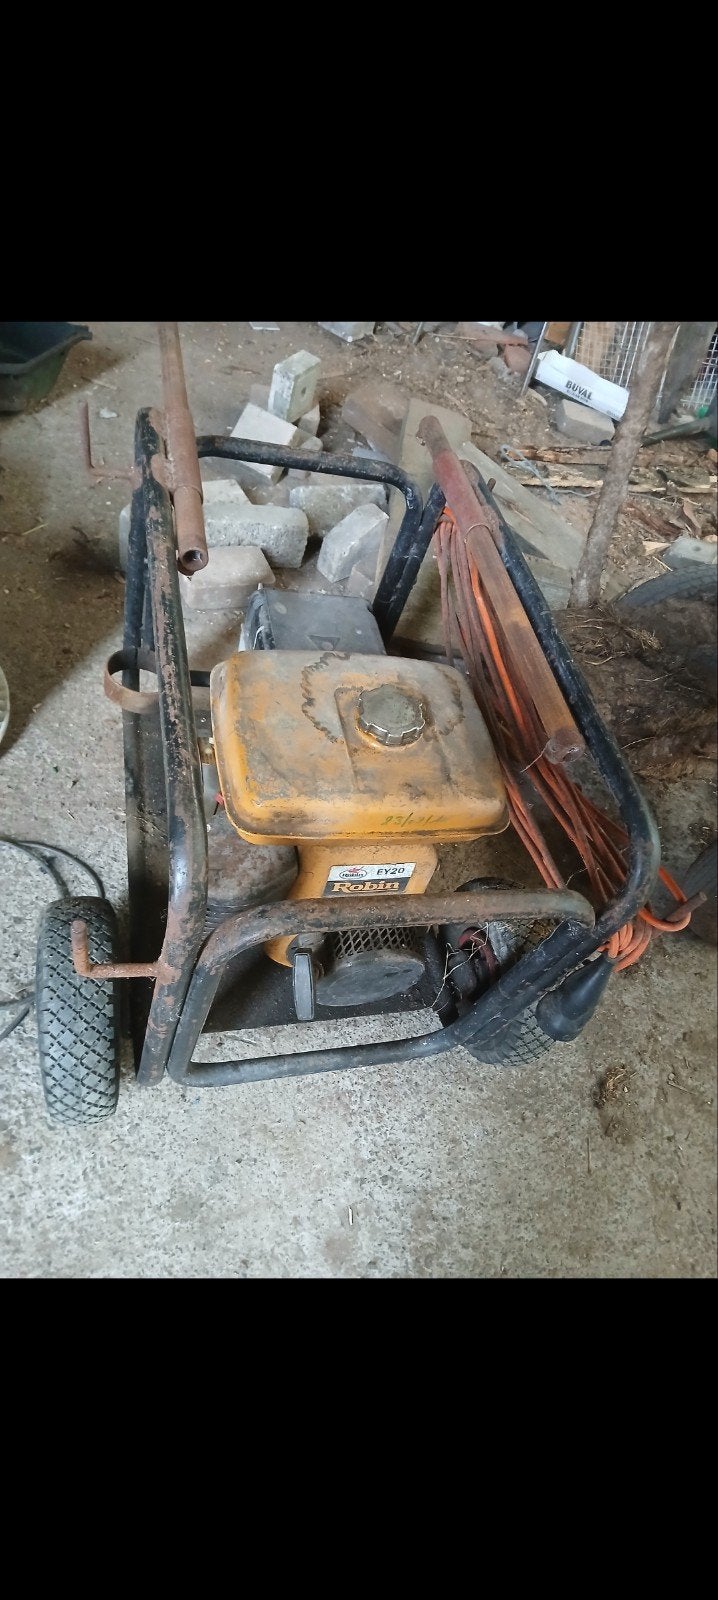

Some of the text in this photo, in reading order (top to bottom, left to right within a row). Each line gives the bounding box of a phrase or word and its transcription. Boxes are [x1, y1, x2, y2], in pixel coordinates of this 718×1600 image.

[565, 380, 592, 400] BUVAL
[376, 867, 405, 876] EY20
[332, 880, 400, 893] Robin
